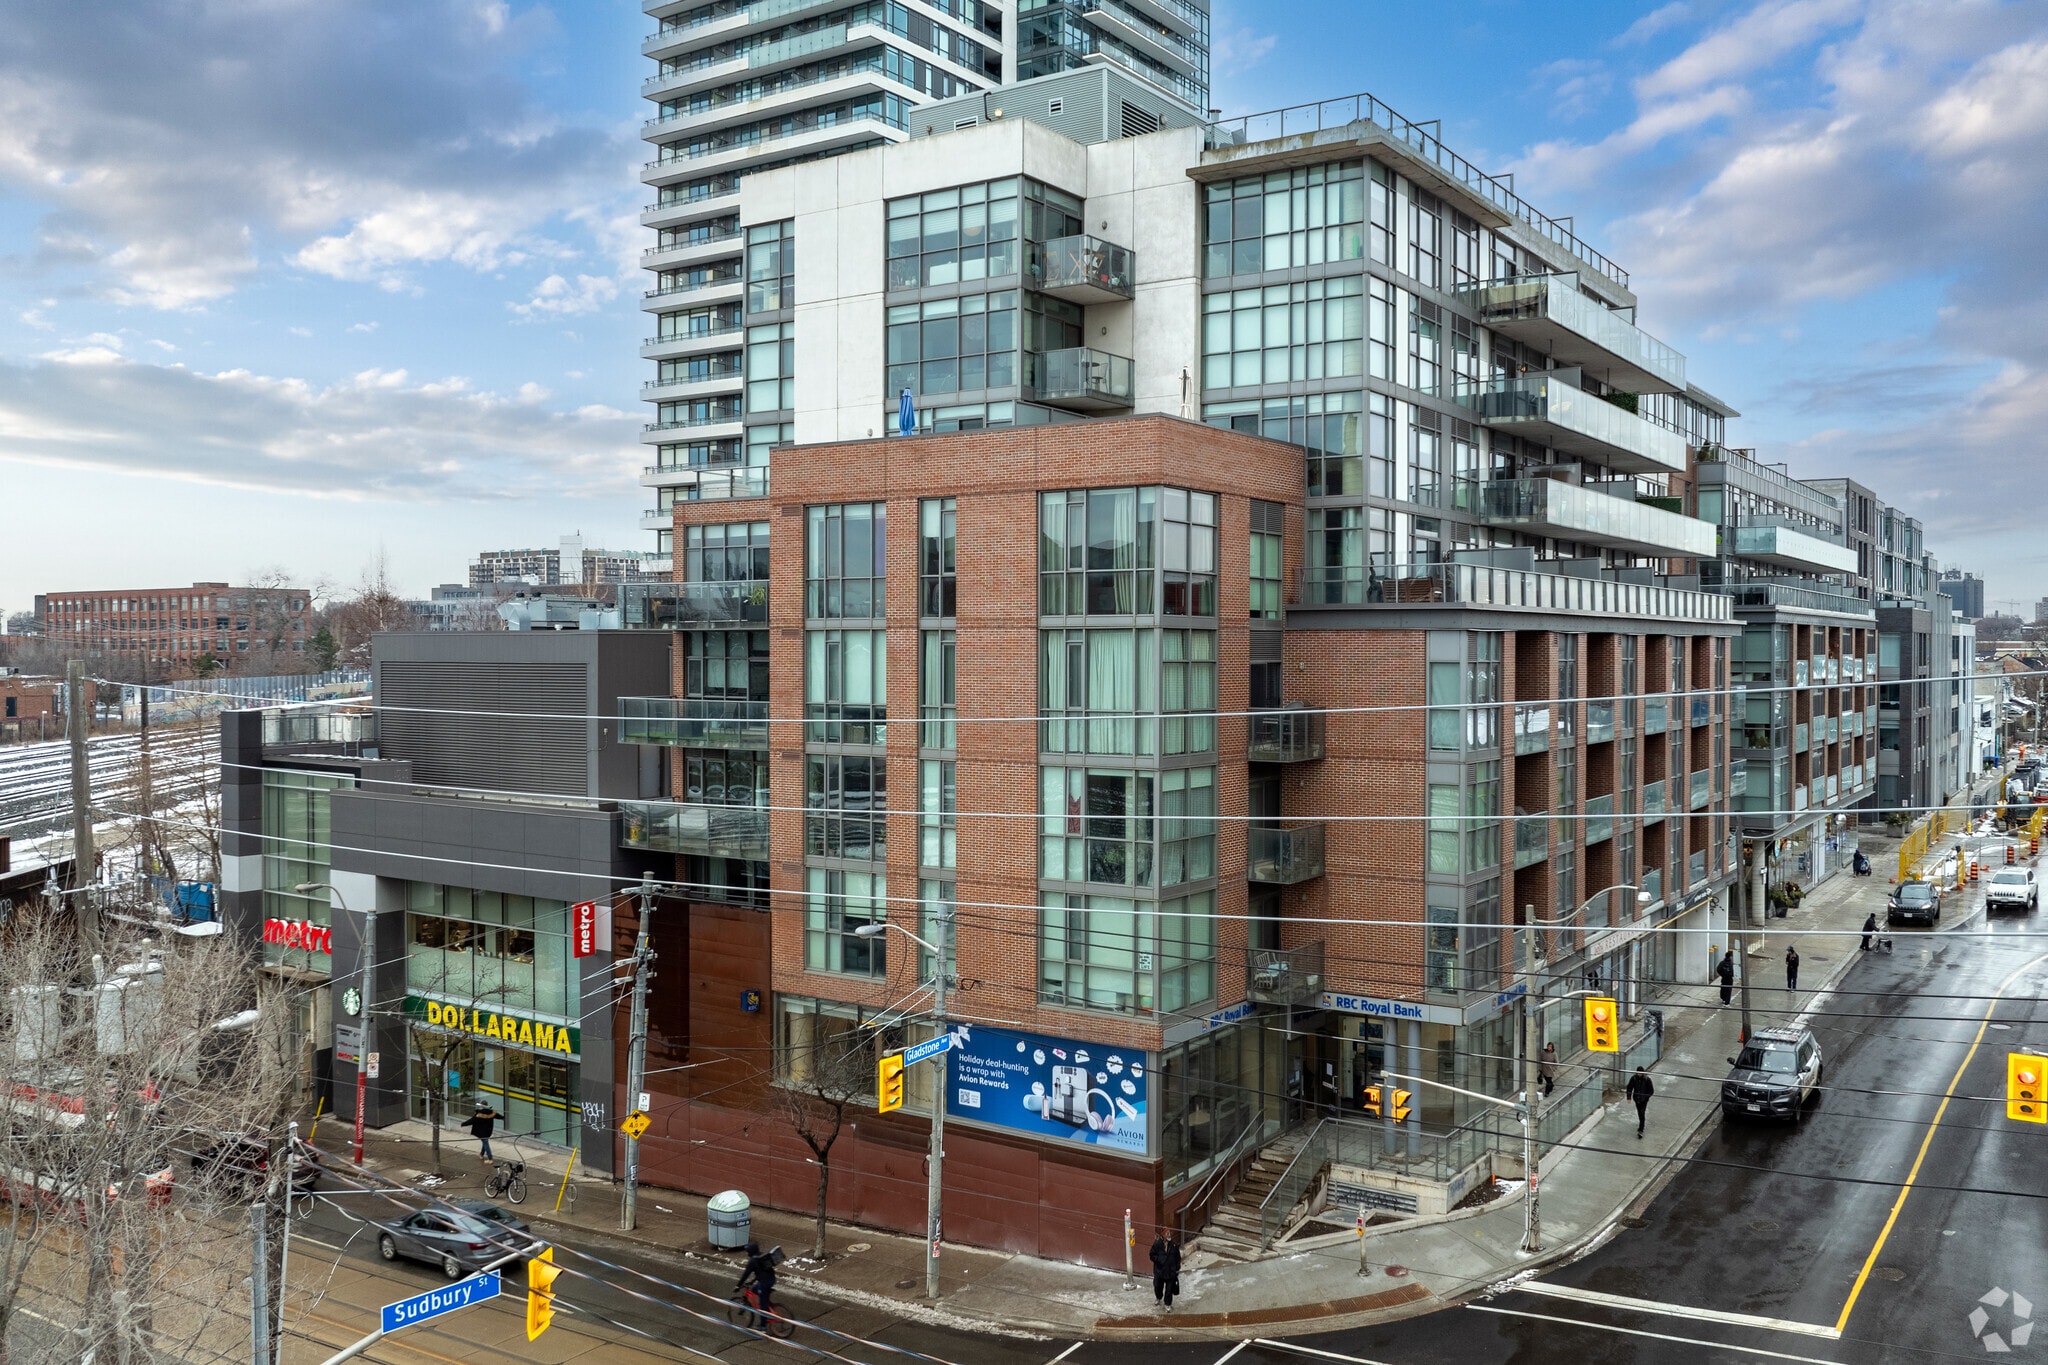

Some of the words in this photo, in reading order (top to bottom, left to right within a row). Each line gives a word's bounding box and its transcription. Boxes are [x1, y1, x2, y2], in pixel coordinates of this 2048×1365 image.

[580, 905, 590, 953] metro
[1336, 996, 1358, 1010] RBC
[1361, 999, 1391, 1015] Royal
[1394, 1003, 1422, 1018] Bank
[427, 1000, 572, 1054] DOLLARAMA
[907, 1041, 940, 1061] Gladstone
[940, 1037, 948, 1045] Ave
[958, 1053, 985, 1067] Holiday
[985, 1057, 1029, 1076] deal-hunting
[958, 1062, 965, 1072] is
[971, 1066, 989, 1078] wrap
[990, 1069, 1006, 1079] with
[958, 1073, 979, 1084] Avion
[979, 1076, 1010, 1090] Rewards
[394, 1285, 472, 1322] Sudbury
[478, 1277, 489, 1288] St
